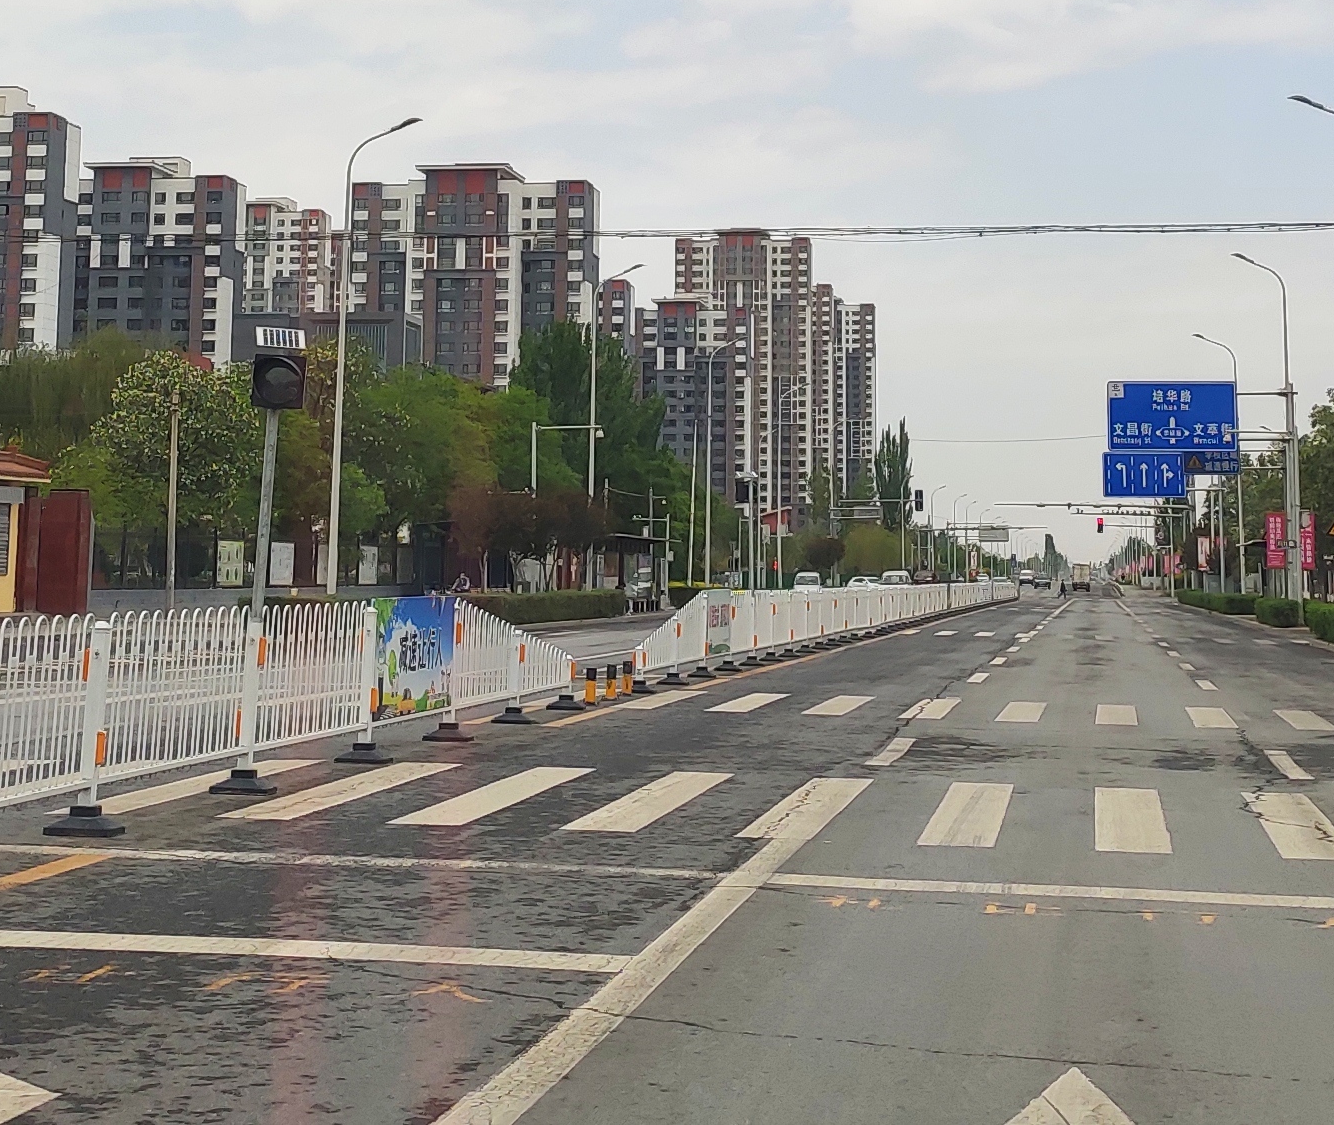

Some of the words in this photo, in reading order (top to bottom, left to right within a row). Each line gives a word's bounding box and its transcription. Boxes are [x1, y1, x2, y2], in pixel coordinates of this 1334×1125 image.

[1152, 388, 1192, 403] 培华路
[1113, 422, 1153, 436] 文昌街
[399, 628, 443, 674] 减速让行人
